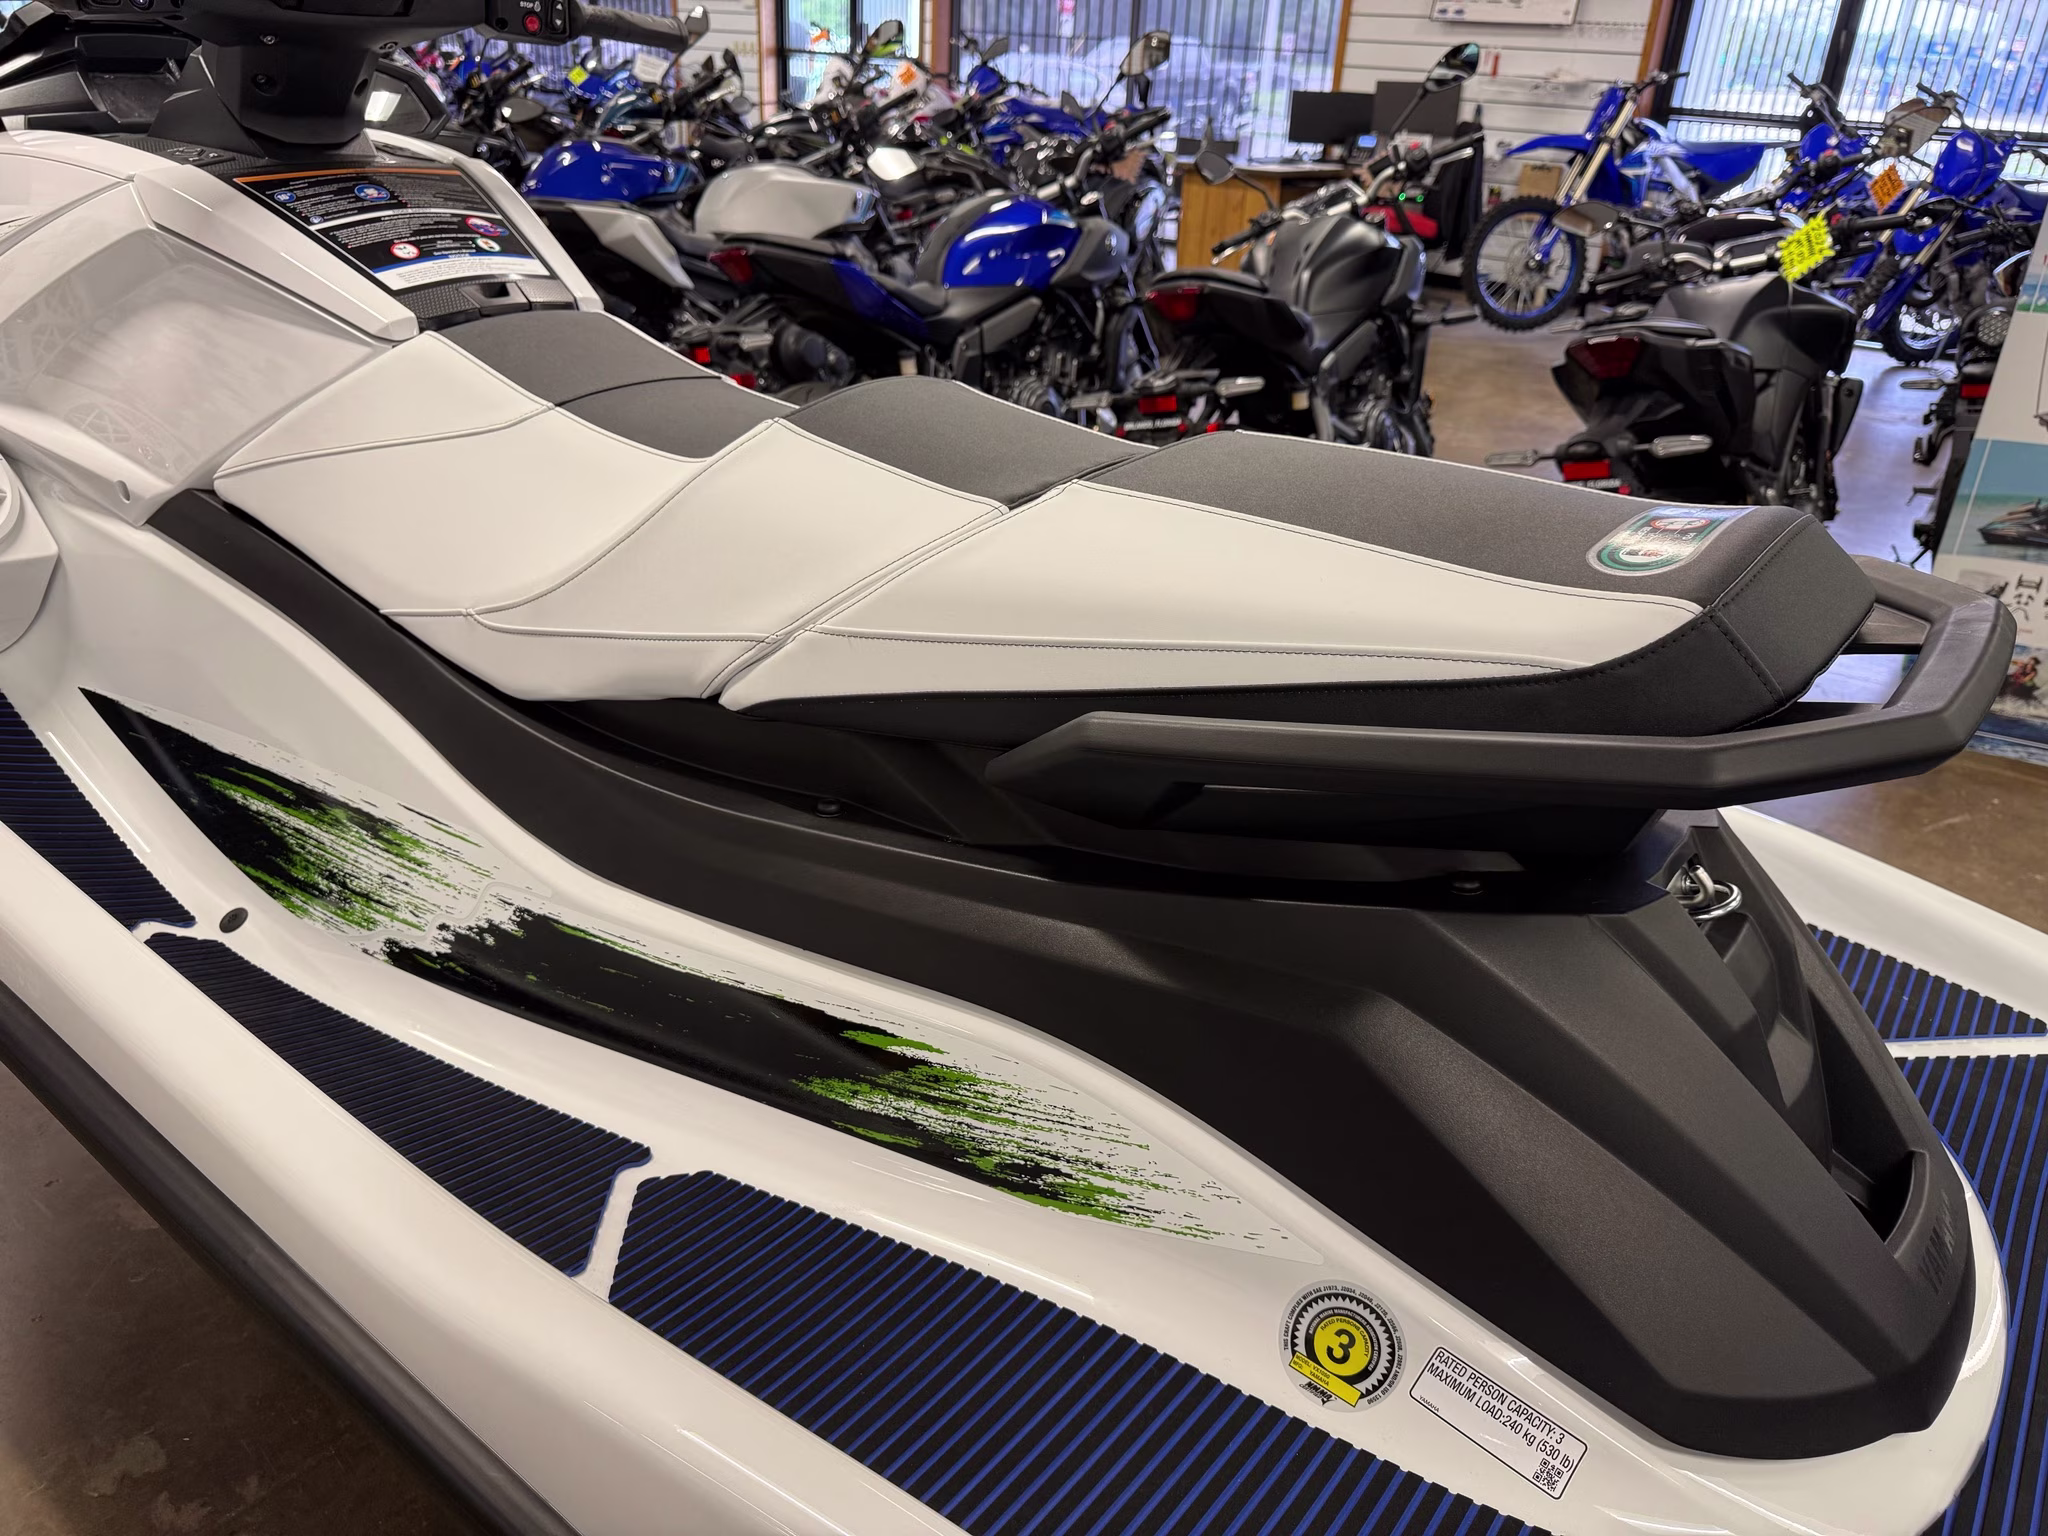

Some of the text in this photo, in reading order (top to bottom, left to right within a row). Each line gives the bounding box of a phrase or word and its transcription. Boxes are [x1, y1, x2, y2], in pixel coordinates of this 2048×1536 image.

[1318, 1309, 1333, 1319] MARINE
[1283, 1320, 1292, 1337] CRAFT
[1288, 1300, 1303, 1320] COMPLIES
[1302, 1291, 1313, 1301] WITH
[1381, 1386, 1389, 1396] ISO
[1320, 1318, 1370, 1358] RATED PERSONS CAPACITY
[1326, 1328, 1356, 1364] 3
[1295, 1353, 1311, 1368] MODEL:
[1309, 1370, 1329, 1386] YAMAHA
[1418, 1395, 1440, 1413] YAMAHA
[1434, 1350, 1566, 1445] RATED PERSON CAPACITY: 3
[1427, 1363, 1575, 1472] MAXIMUM LOAD:240 kg (530 lb)
